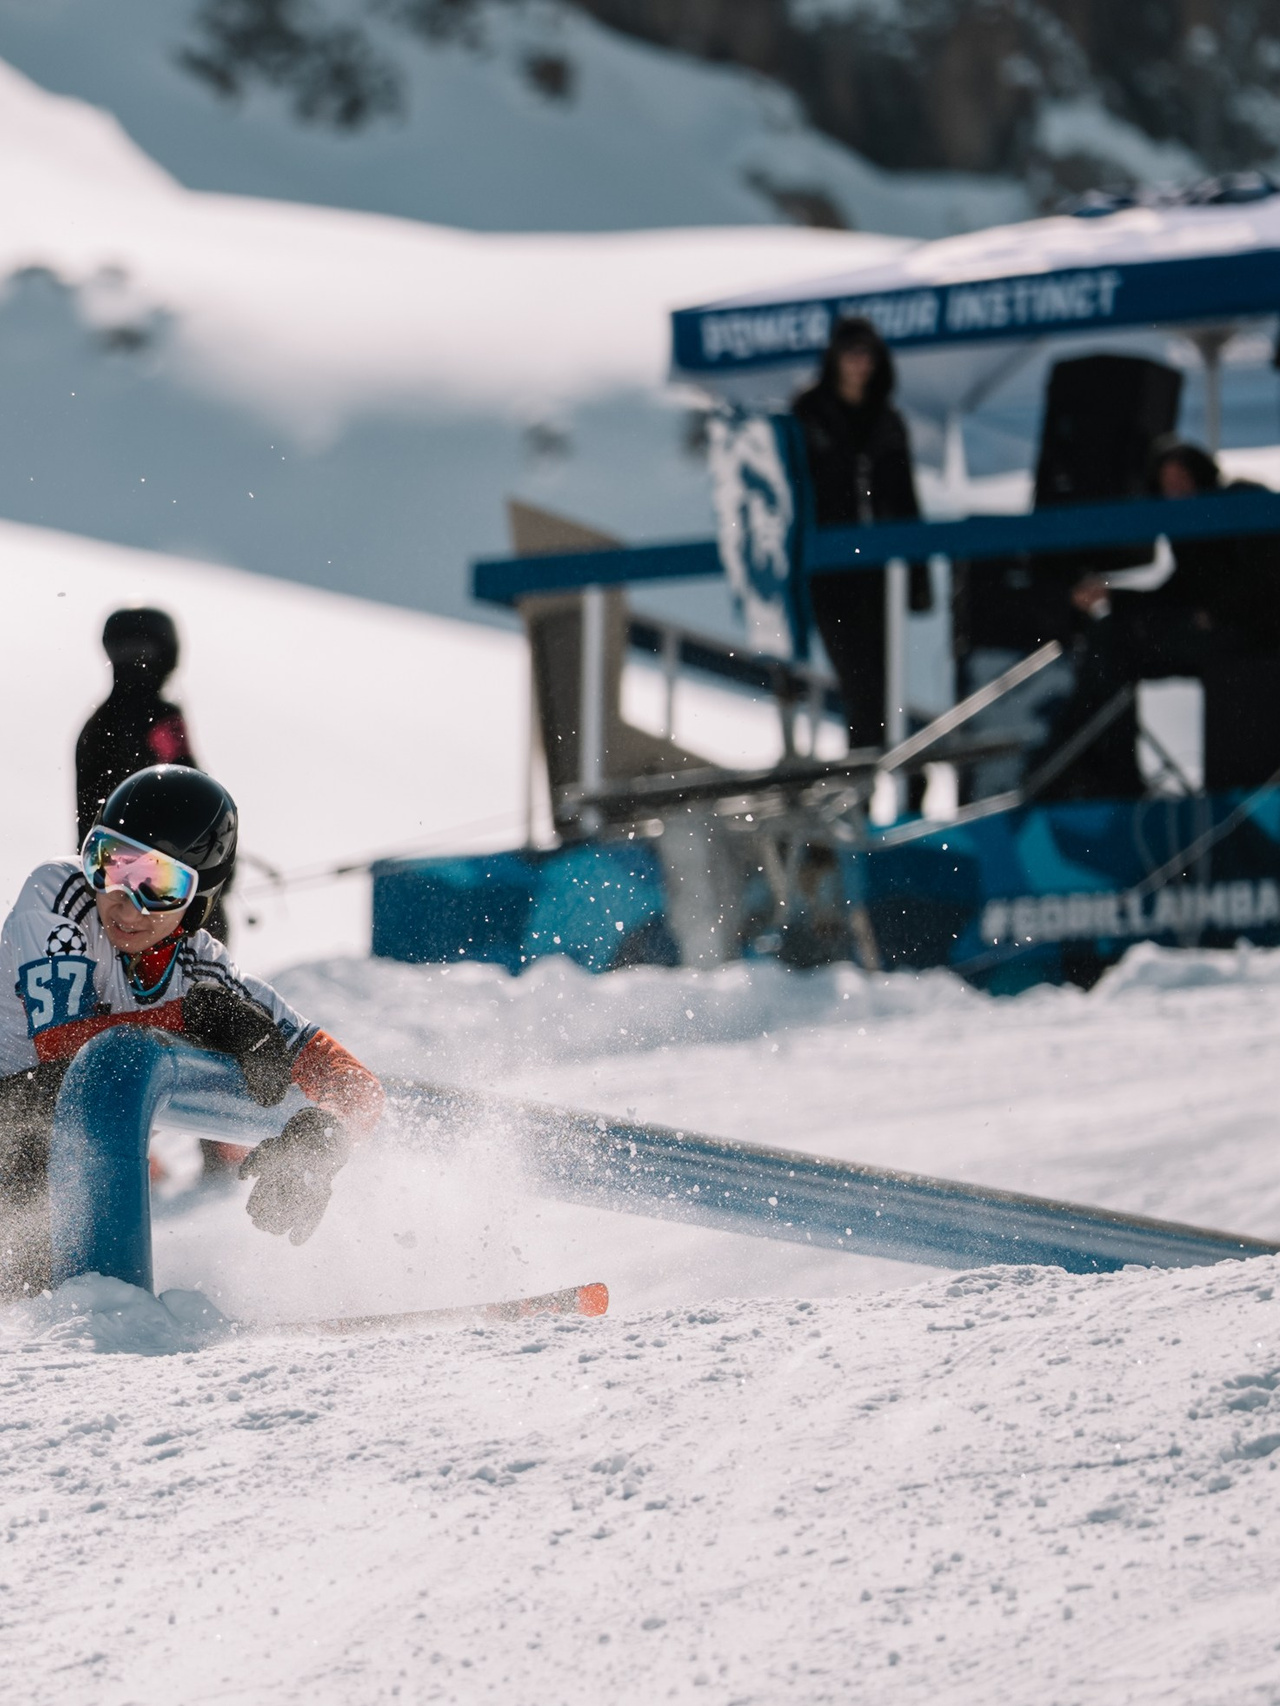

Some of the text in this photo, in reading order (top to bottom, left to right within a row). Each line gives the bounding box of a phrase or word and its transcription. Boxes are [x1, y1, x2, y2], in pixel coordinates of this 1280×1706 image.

[700, 304, 829, 362] POWER
[946, 268, 1120, 332] INSTINCT
[26, 961, 88, 1028] 57
